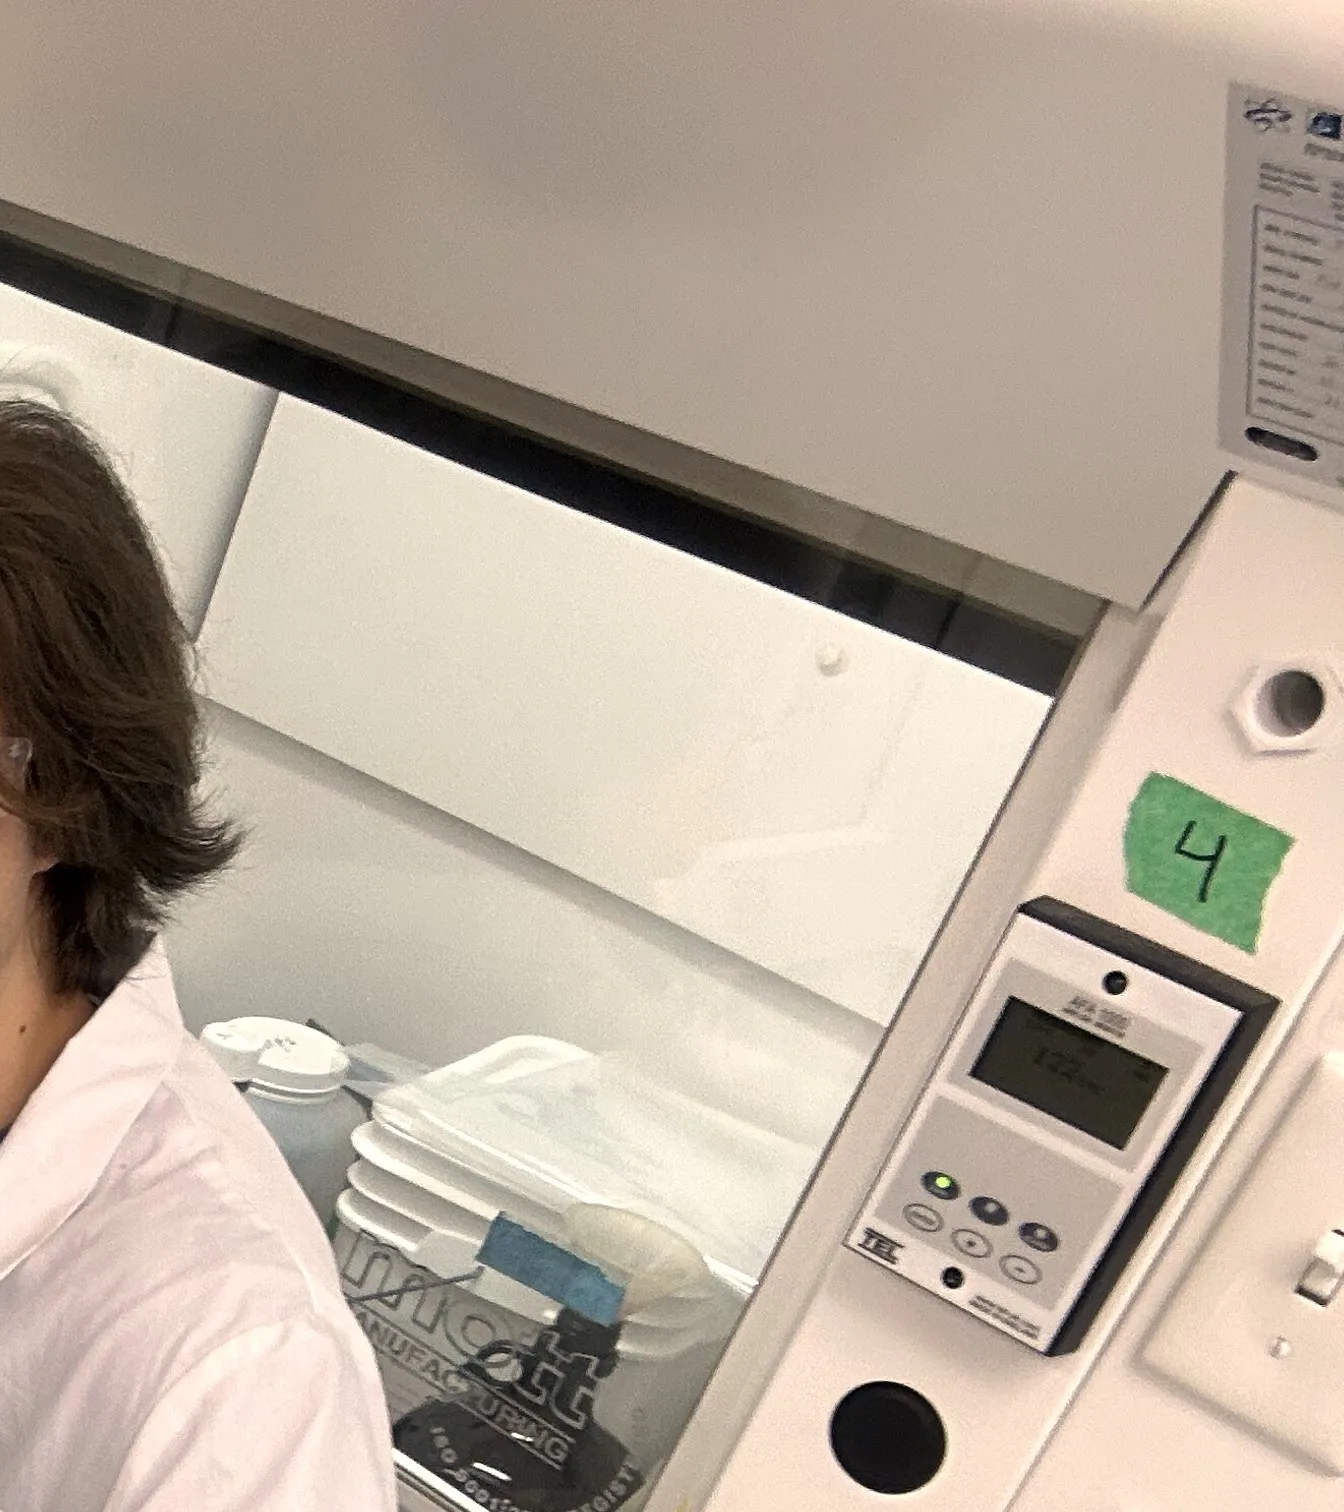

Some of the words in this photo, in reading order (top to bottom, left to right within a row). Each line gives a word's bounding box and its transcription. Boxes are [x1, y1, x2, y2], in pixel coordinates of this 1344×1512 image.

[1174, 820, 1227, 903] 4
[342, 1229, 599, 1431] mott
[356, 1304, 570, 1465] ANUFACURING
